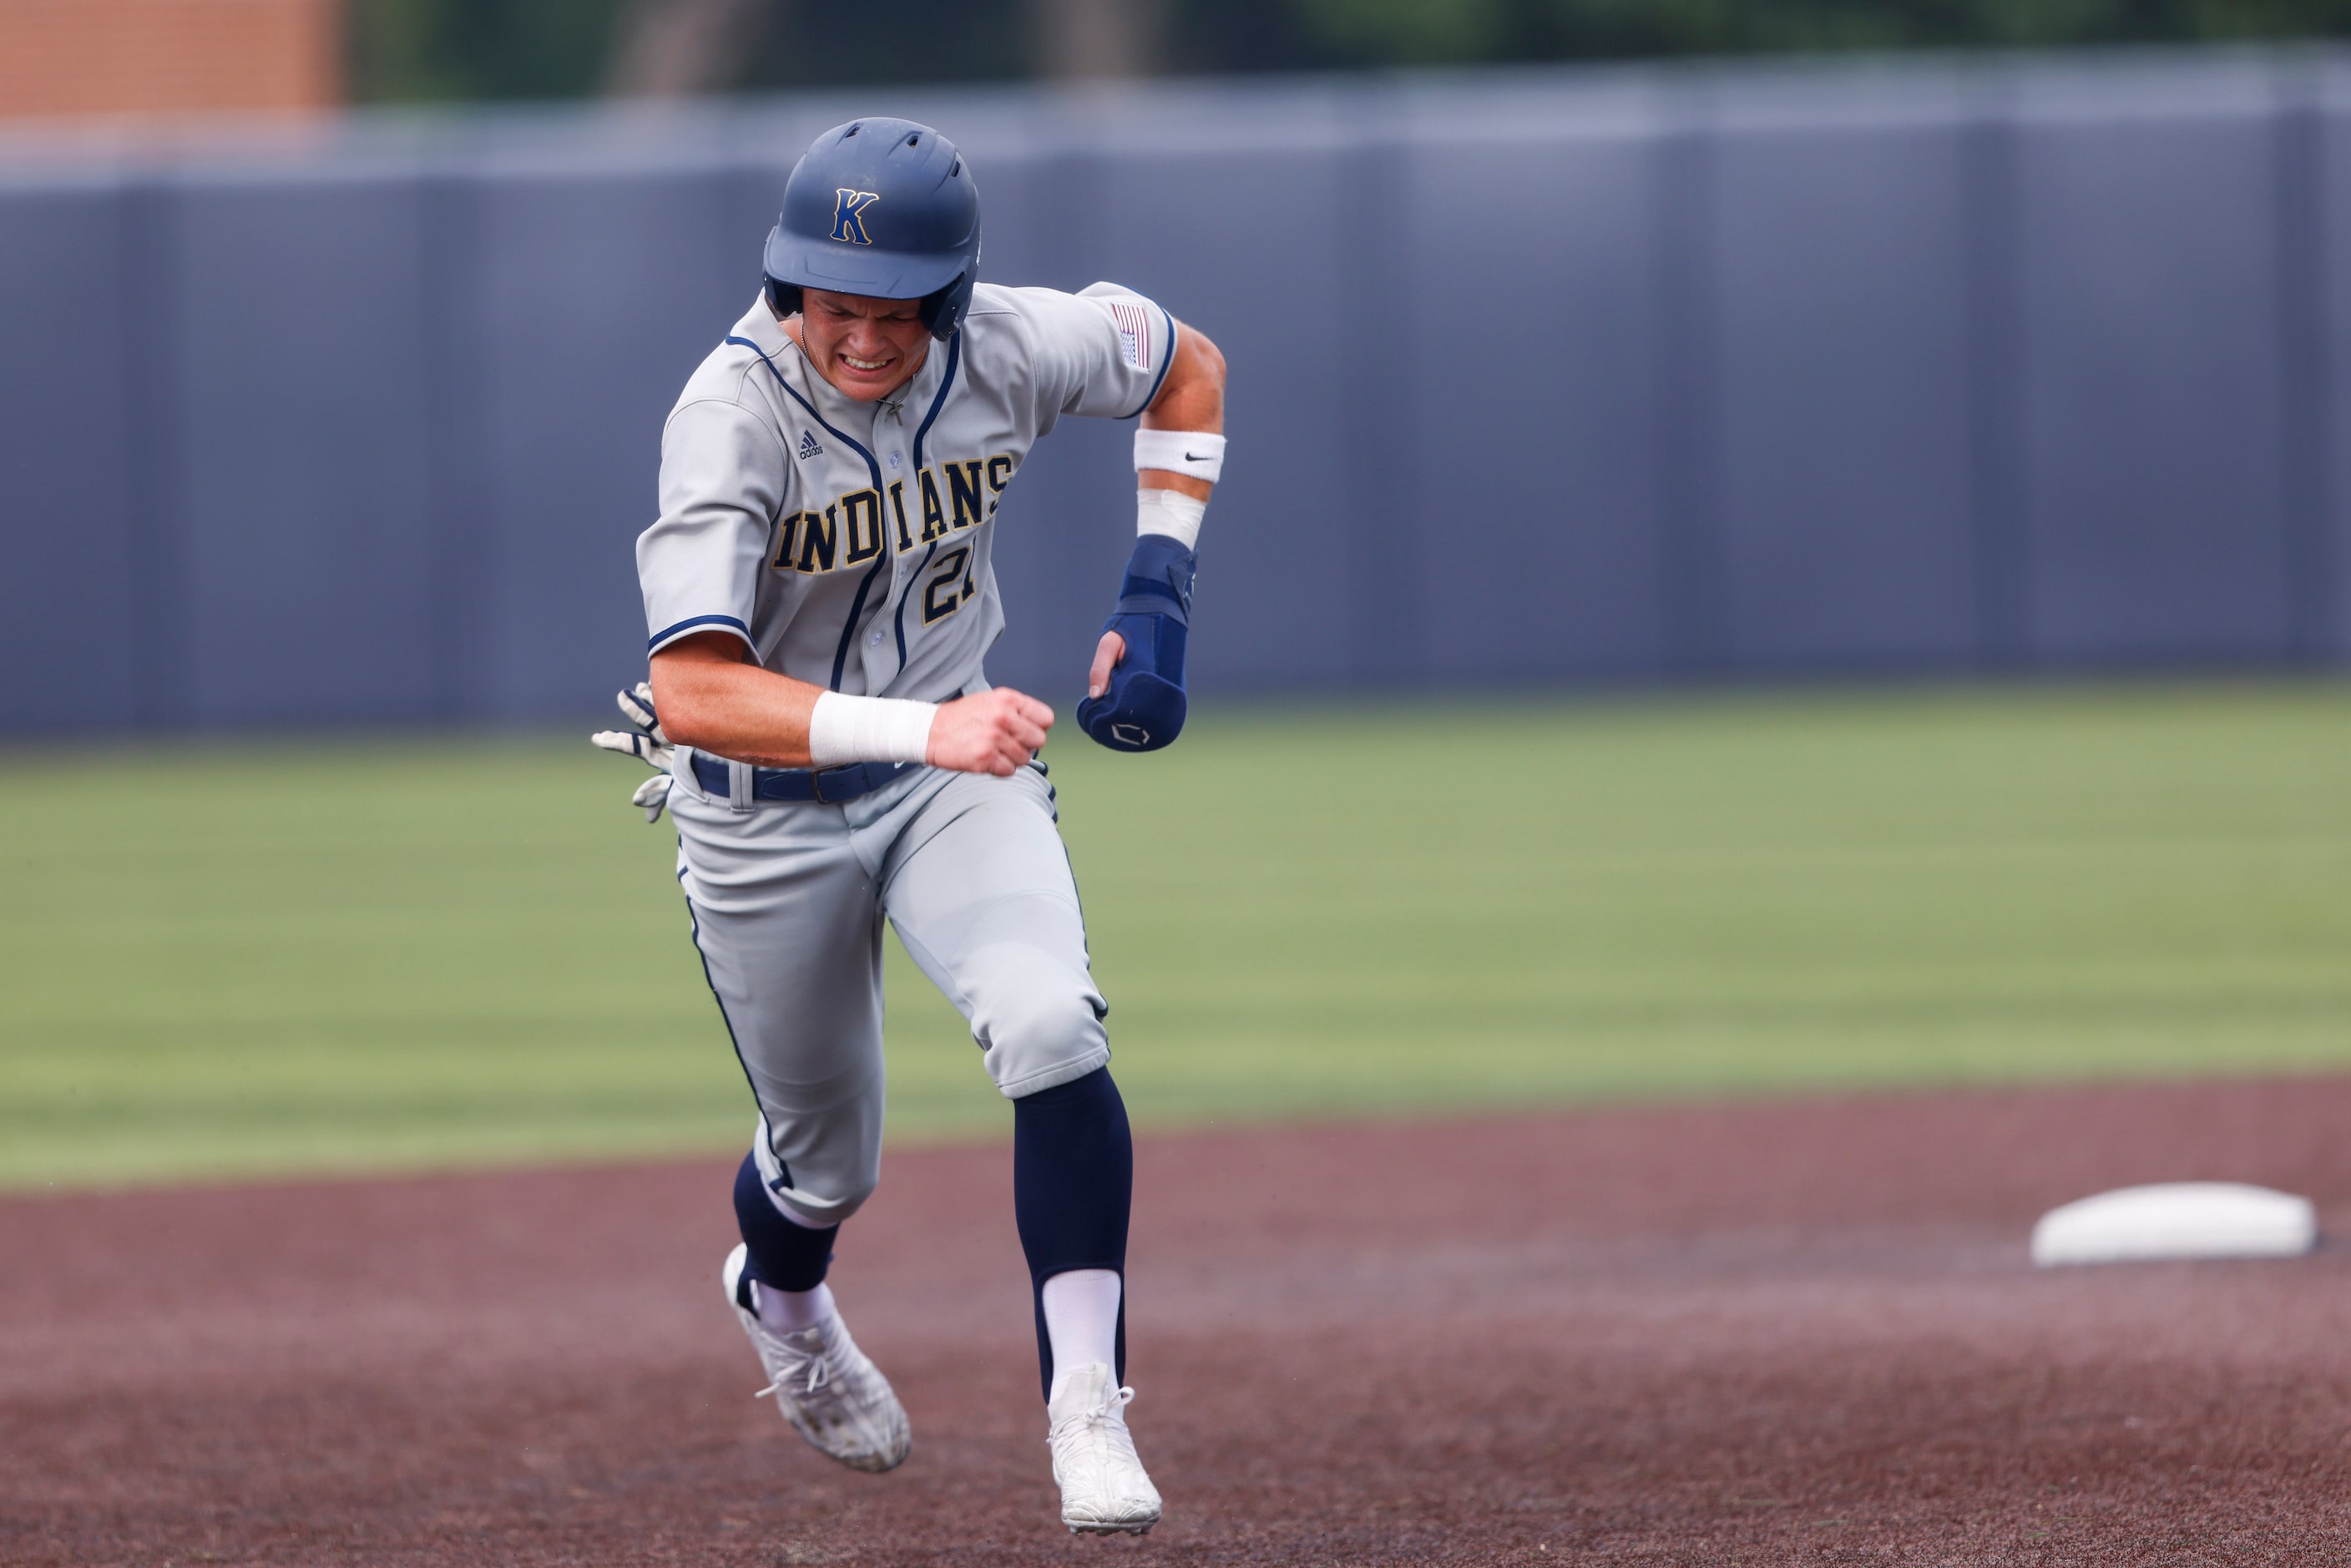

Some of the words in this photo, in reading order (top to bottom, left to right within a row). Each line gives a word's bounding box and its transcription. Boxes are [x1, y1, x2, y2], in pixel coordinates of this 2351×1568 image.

[830, 188, 879, 245] K
[800, 446, 823, 460] adidas
[771, 453, 1014, 575] INDIANS
